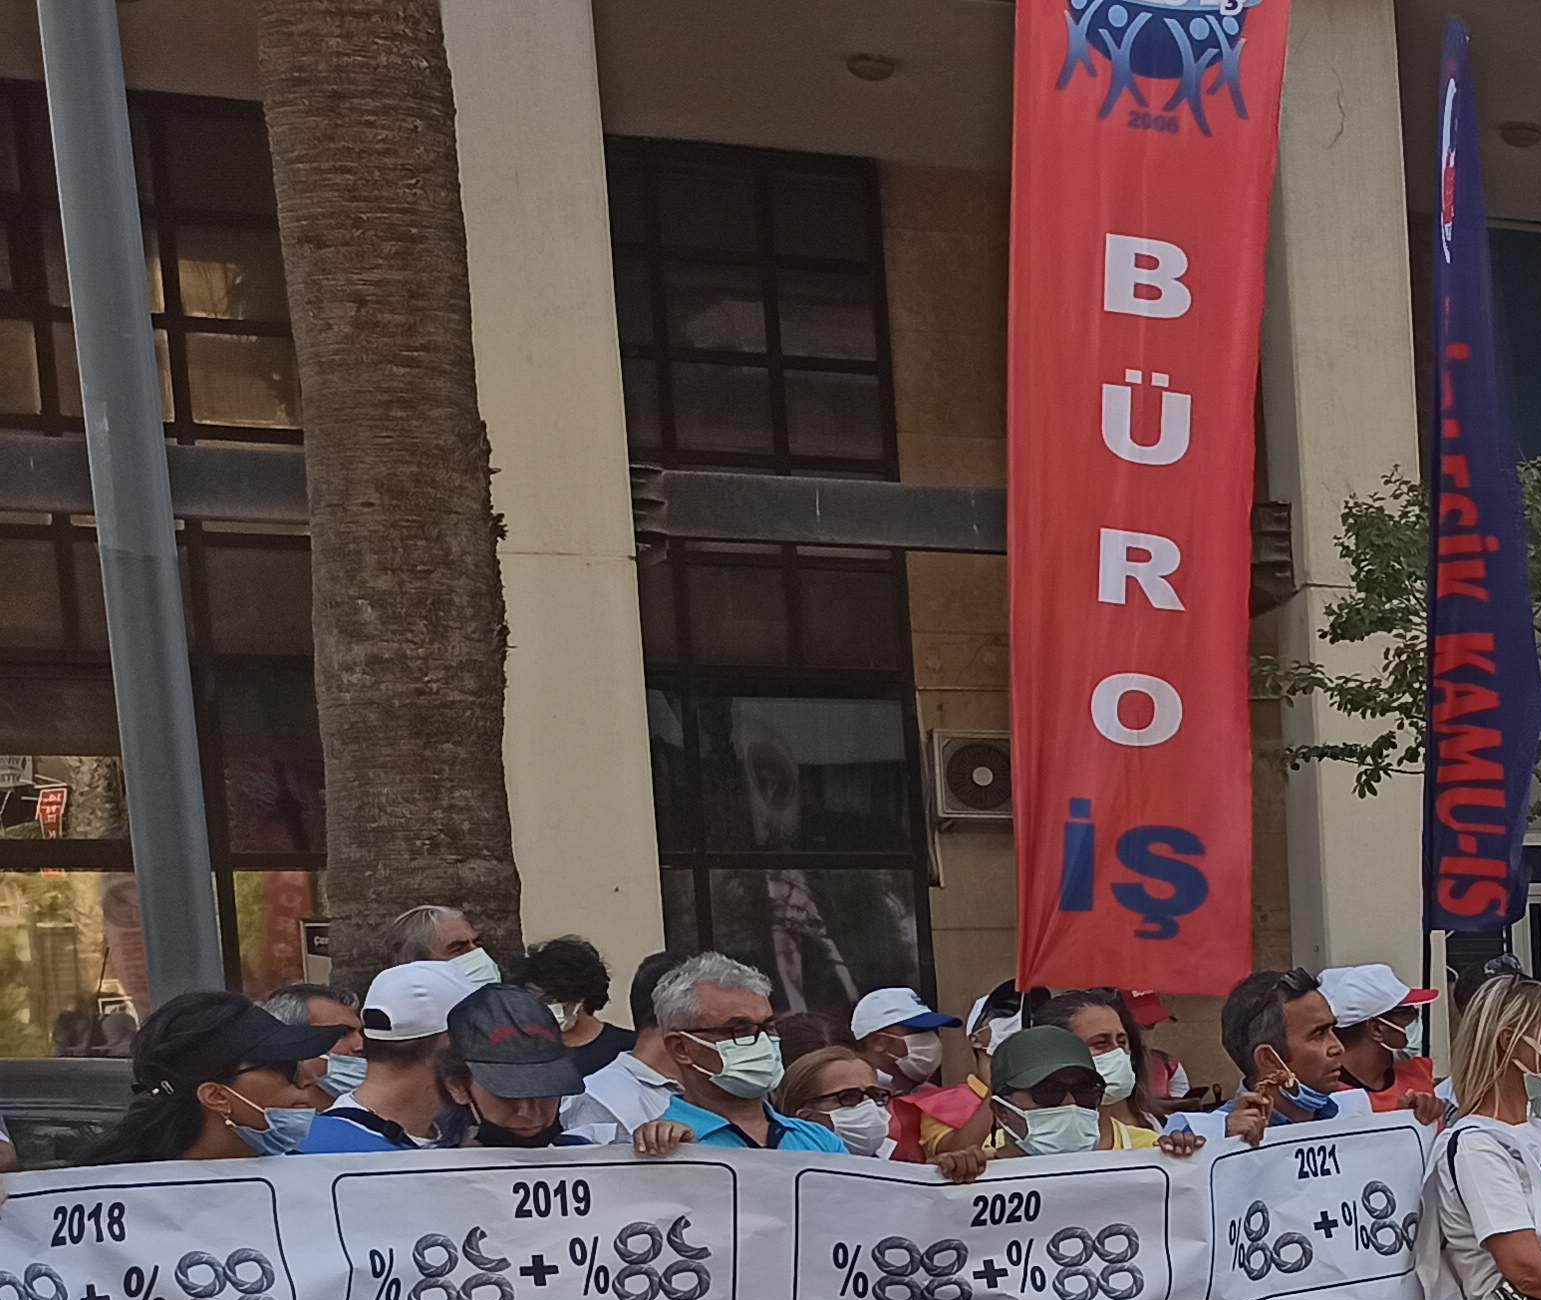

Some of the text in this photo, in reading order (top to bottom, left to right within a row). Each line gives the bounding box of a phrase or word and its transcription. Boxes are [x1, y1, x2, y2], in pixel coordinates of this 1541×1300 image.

[1058, 232, 1209, 941] BÜRO İŞ
[1294, 1143, 1340, 1180] 2021
[511, 1178, 593, 1219] 2019
[971, 1190, 1042, 1228] 2020
[50, 1201, 126, 1247] 2018
